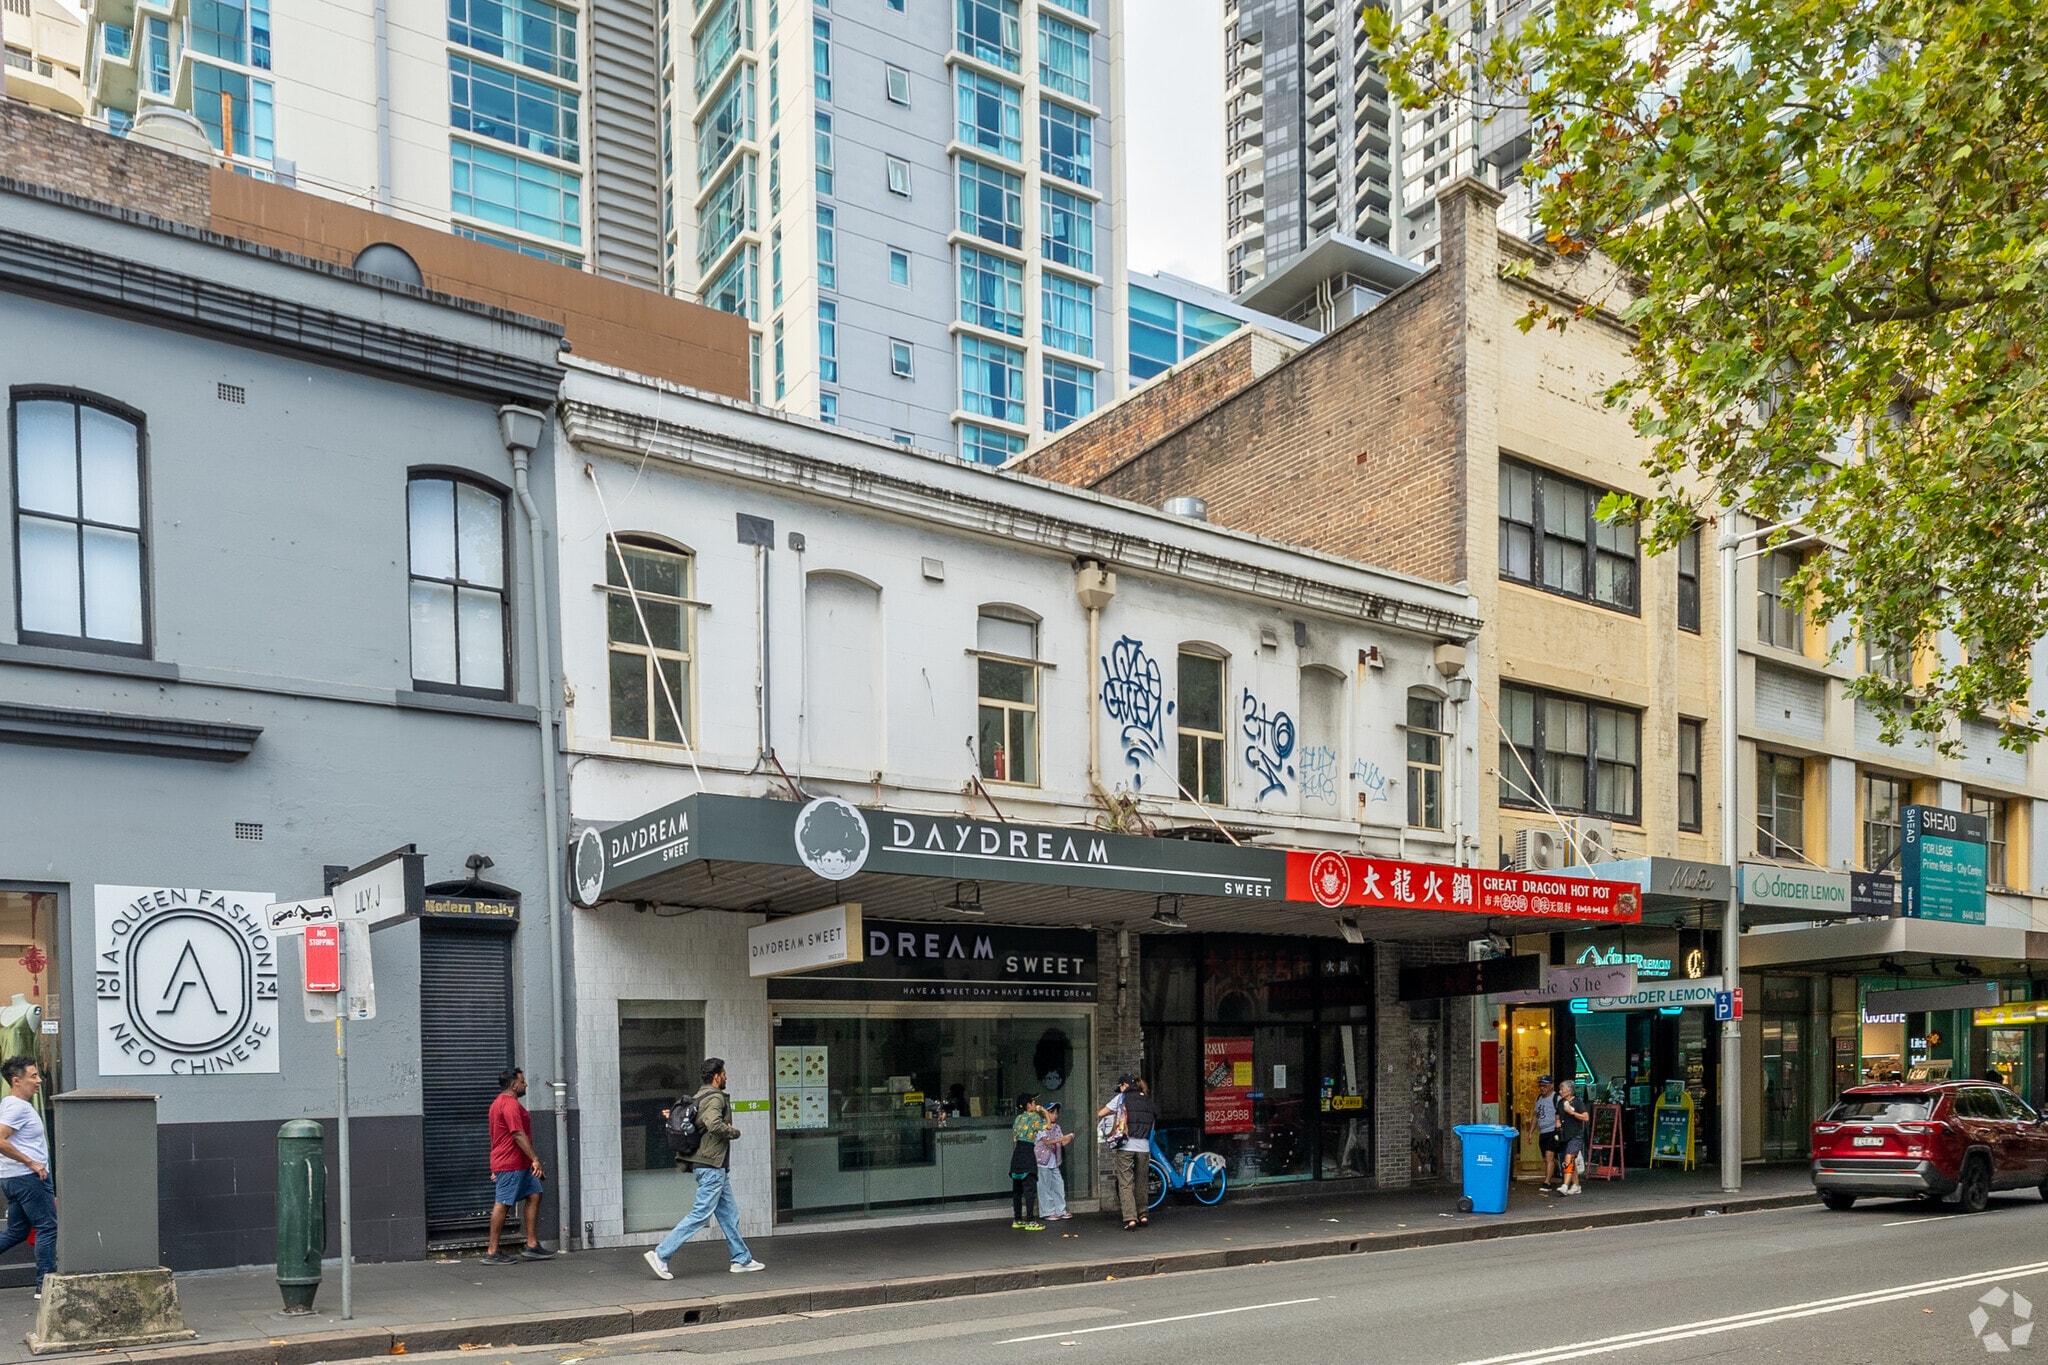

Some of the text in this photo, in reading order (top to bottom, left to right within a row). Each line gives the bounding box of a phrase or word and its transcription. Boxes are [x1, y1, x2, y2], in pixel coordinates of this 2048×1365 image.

[1906, 808, 1915, 844] SHEAD
[1923, 811, 1957, 832] SHEAD
[612, 812, 689, 859] DAYDREAM
[893, 818, 1109, 864] DAYDREAM
[663, 842, 689, 862] SWEET
[1923, 843, 1953, 857] FOR LEASE
[1923, 859, 1938, 871] Prime
[1224, 882, 1271, 897] SWEET
[1362, 864, 1473, 906] 大龍火鍋
[1483, 877, 1611, 900] GREAT DRAGON HOT POT
[1811, 885, 1844, 901] LEMON
[425, 900, 514, 917] Modern Realty
[102, 888, 272, 967] A-QUEEN FASHION
[309, 938, 334, 946] STOPPING
[752, 927, 842, 957] DAYDREAM SWEET
[1006, 956, 1084, 975] SWEET
[1643, 959, 1671, 970] LEMON
[97, 978, 120, 992] 20
[257, 981, 278, 994] 24
[903, 987, 927, 995] HAVE
[1033, 989, 1060, 997] SWEET
[1669, 986, 1717, 1001] LEMON
[1719, 1004, 1728, 1018] P
[110, 1022, 270, 1075] NEO CHINESE
[1205, 1043, 1226, 1055] R&W
[1205, 1060, 1219, 1070] For
